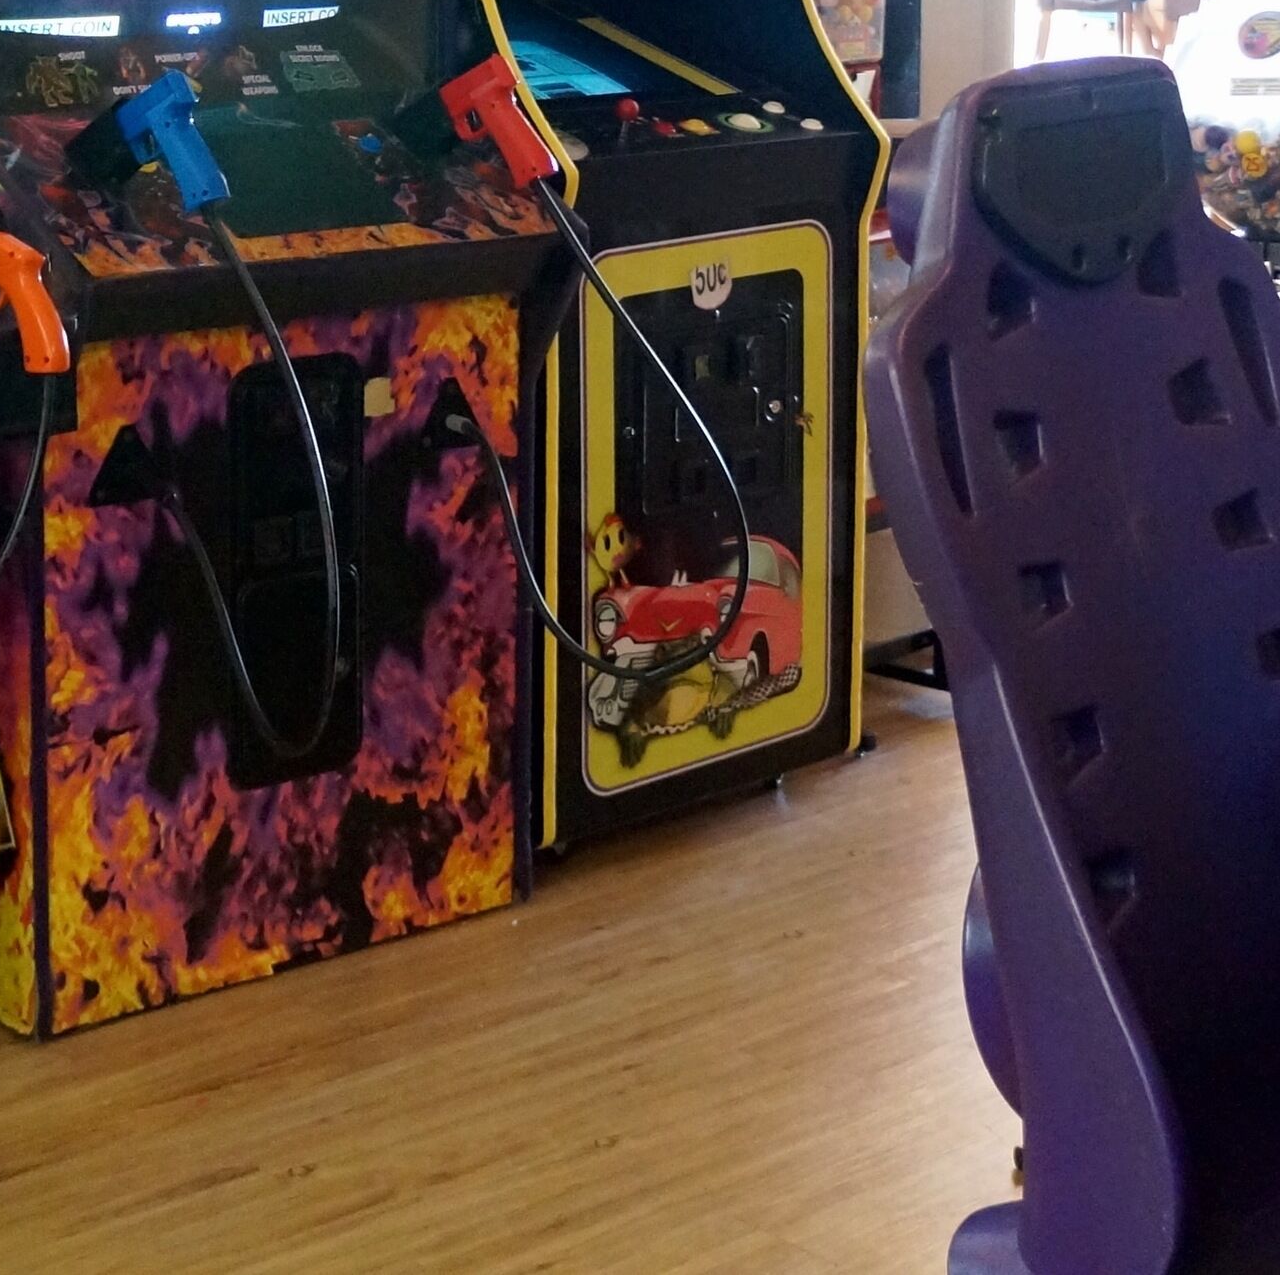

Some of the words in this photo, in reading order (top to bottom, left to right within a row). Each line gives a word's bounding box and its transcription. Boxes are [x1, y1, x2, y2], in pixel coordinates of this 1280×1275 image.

[266, 10, 313, 24] INSERT
[0, 22, 63, 35] INSERT
[70, 19, 113, 35] COIN
